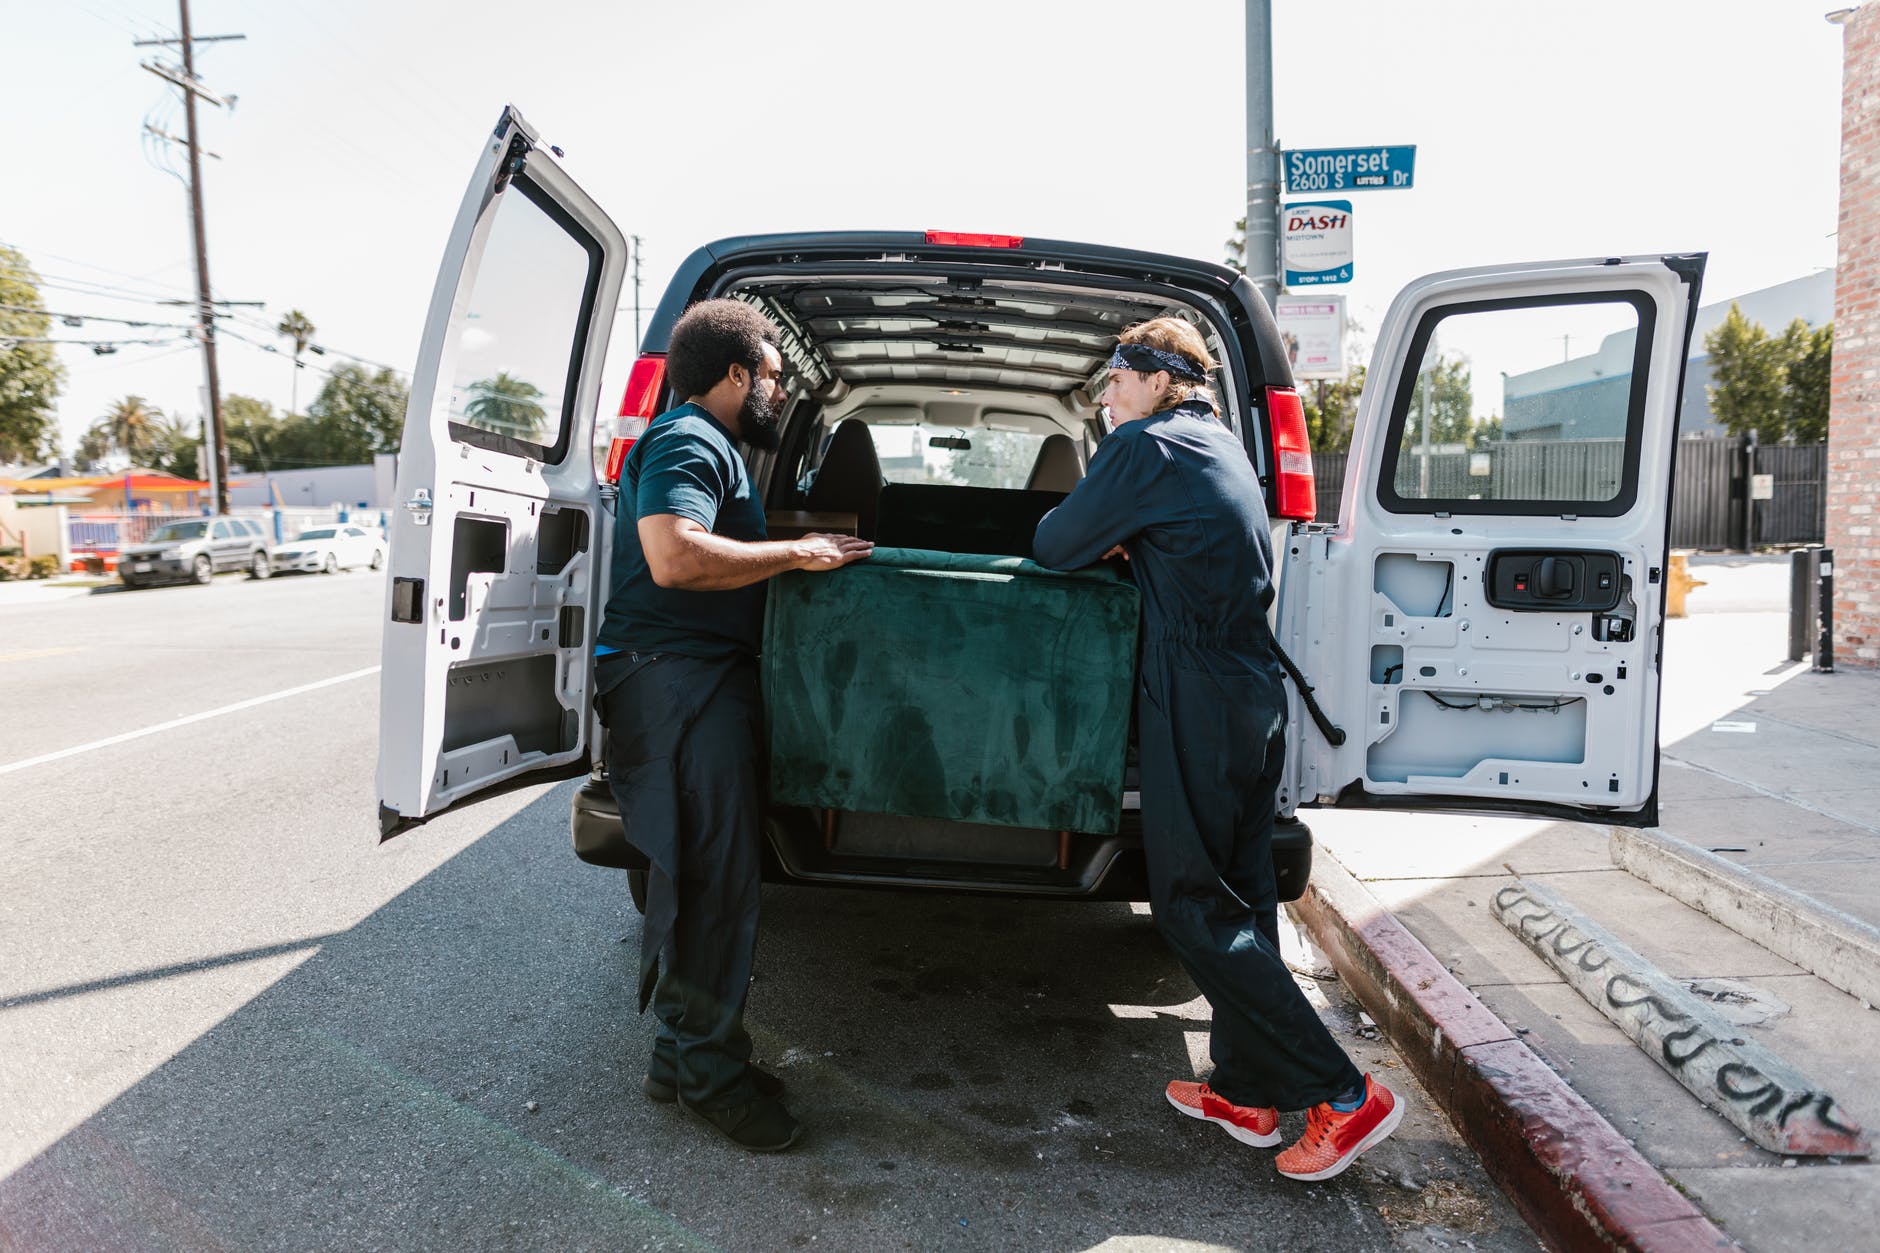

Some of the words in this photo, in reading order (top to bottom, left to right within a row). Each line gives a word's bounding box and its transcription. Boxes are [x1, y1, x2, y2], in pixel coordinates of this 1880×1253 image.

[1291, 149, 1389, 175] Somerset
[1291, 174, 1328, 190] 2600
[1335, 173, 1344, 189] S
[1393, 171, 1409, 186] Dr
[1288, 214, 1347, 231] DASH
[1286, 233, 1324, 241] MIDTOWN
